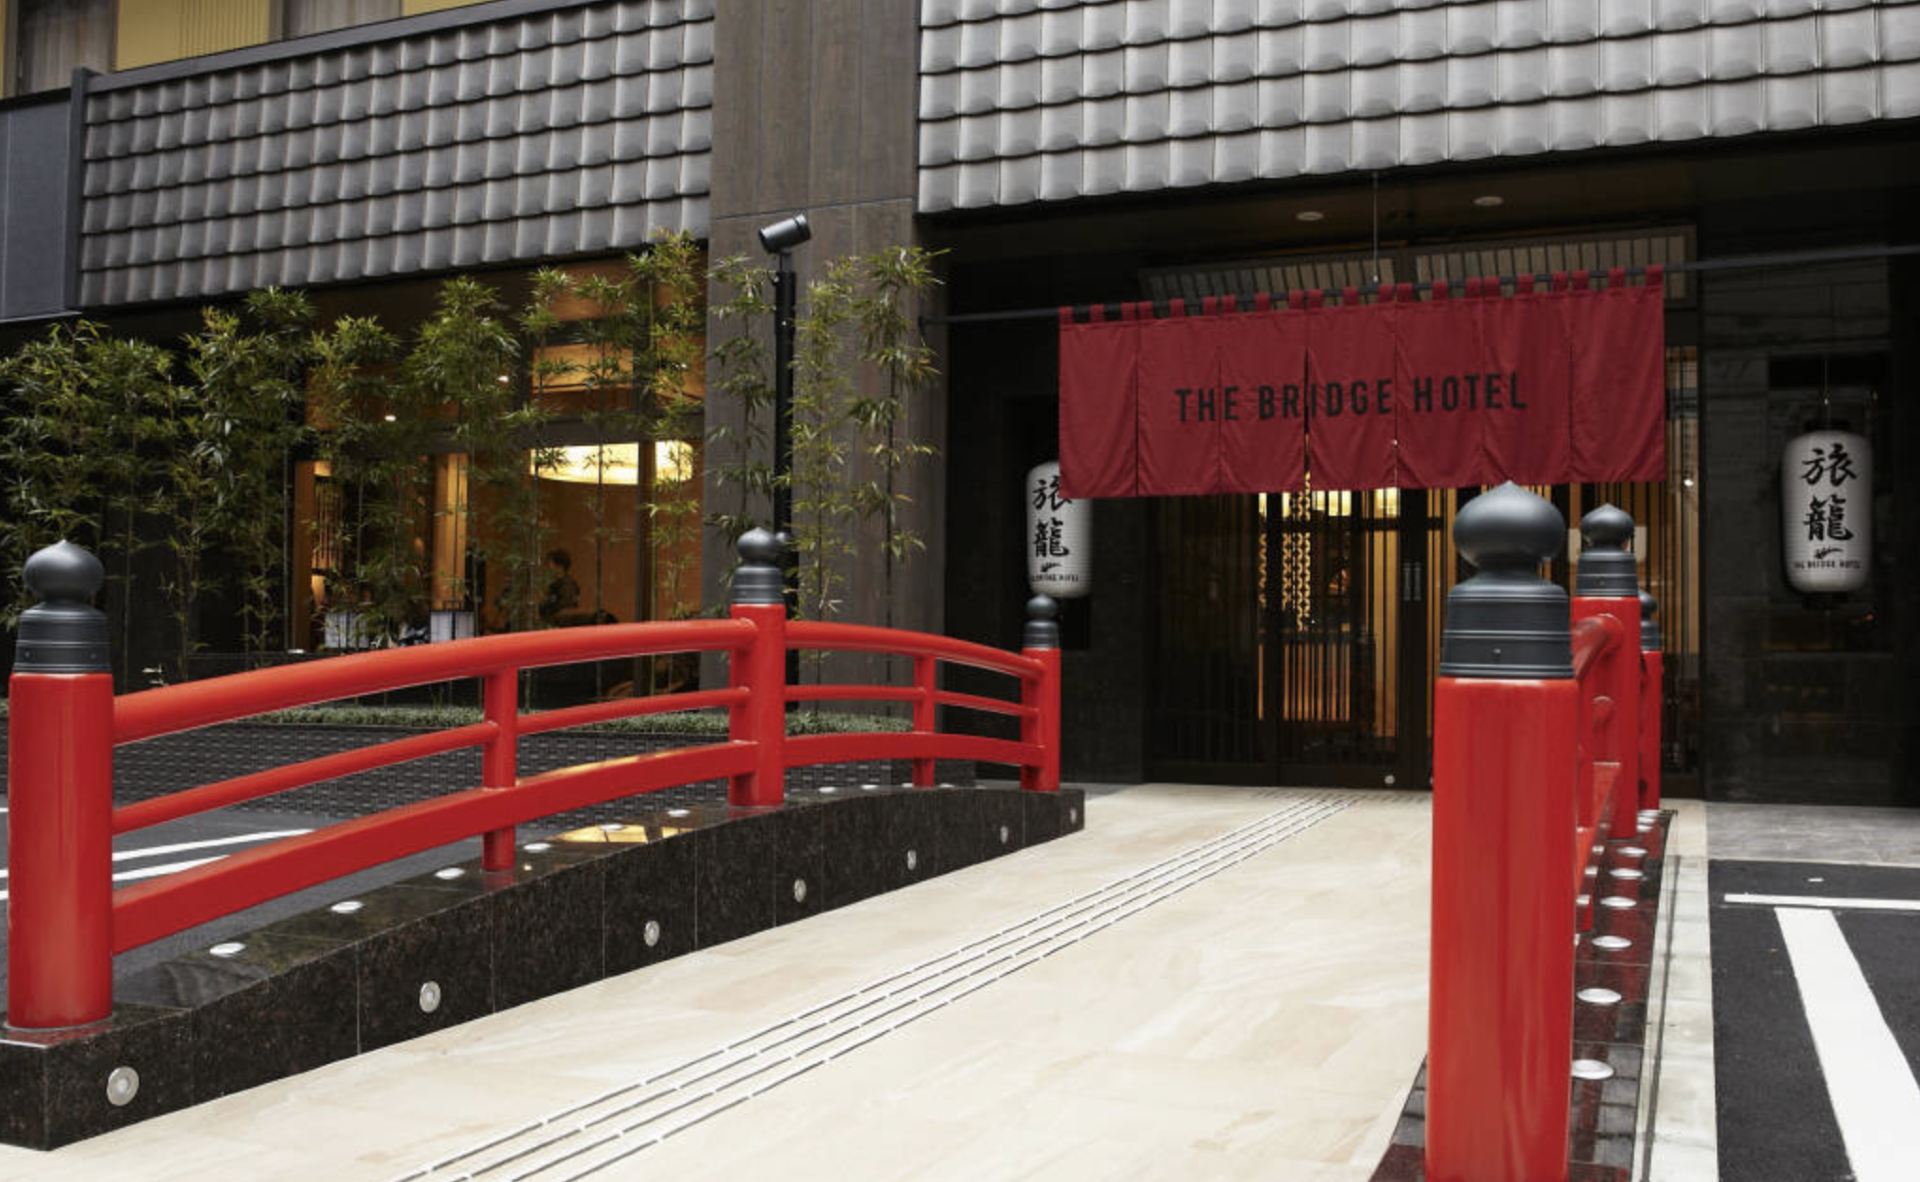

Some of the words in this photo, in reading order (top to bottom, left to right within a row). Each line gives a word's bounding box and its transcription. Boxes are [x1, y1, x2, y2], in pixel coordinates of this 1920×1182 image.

[1175, 387, 1240, 422] THE
[1258, 379, 1392, 420] BRIDGE
[1413, 372, 1527, 412] HOTEL
[1801, 443, 1857, 541] 旅籠
